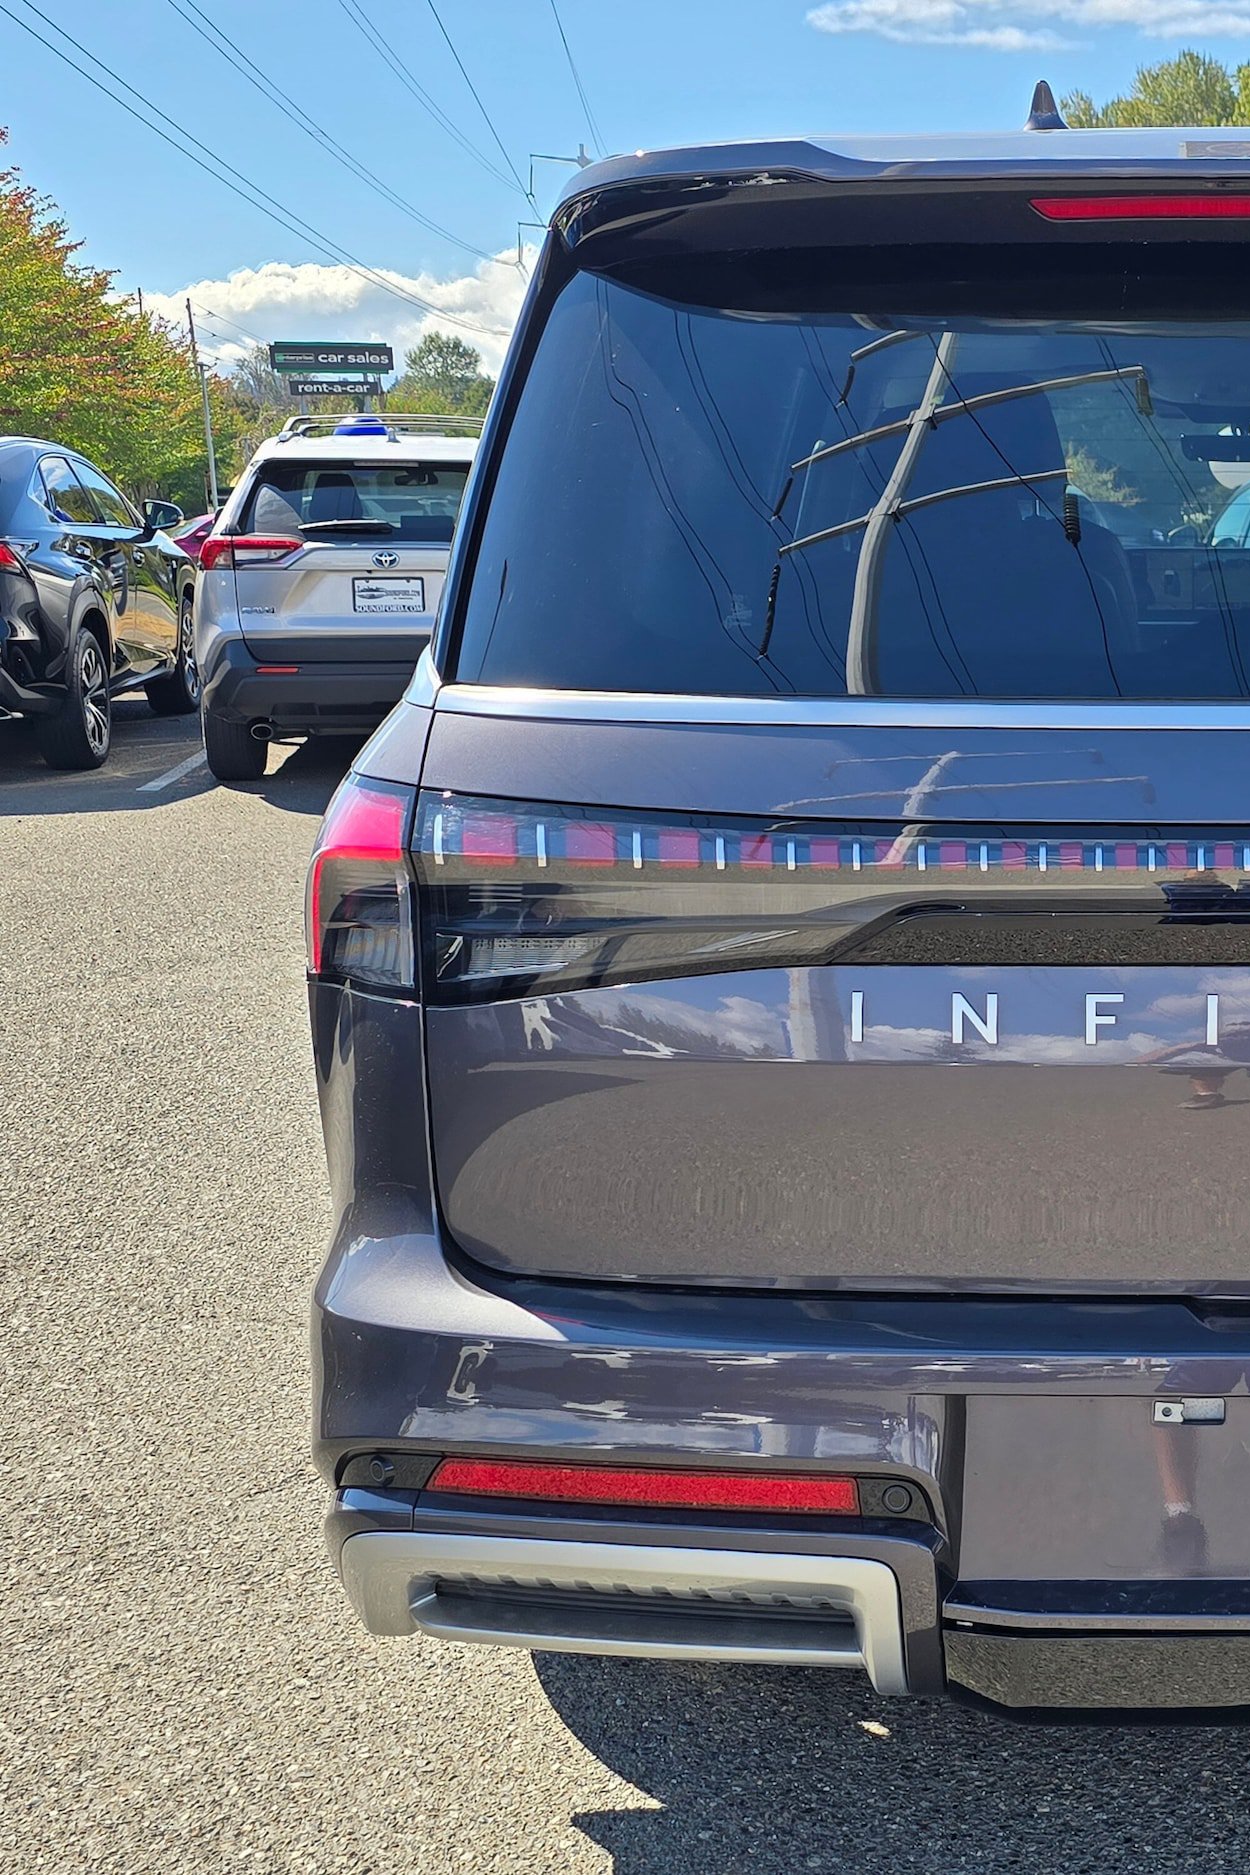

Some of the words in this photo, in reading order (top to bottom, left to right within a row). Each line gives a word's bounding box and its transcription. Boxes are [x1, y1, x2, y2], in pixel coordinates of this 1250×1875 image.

[318, 353, 344, 363] car
[347, 352, 389, 364] sales
[298, 383, 370, 393] rent-a-car
